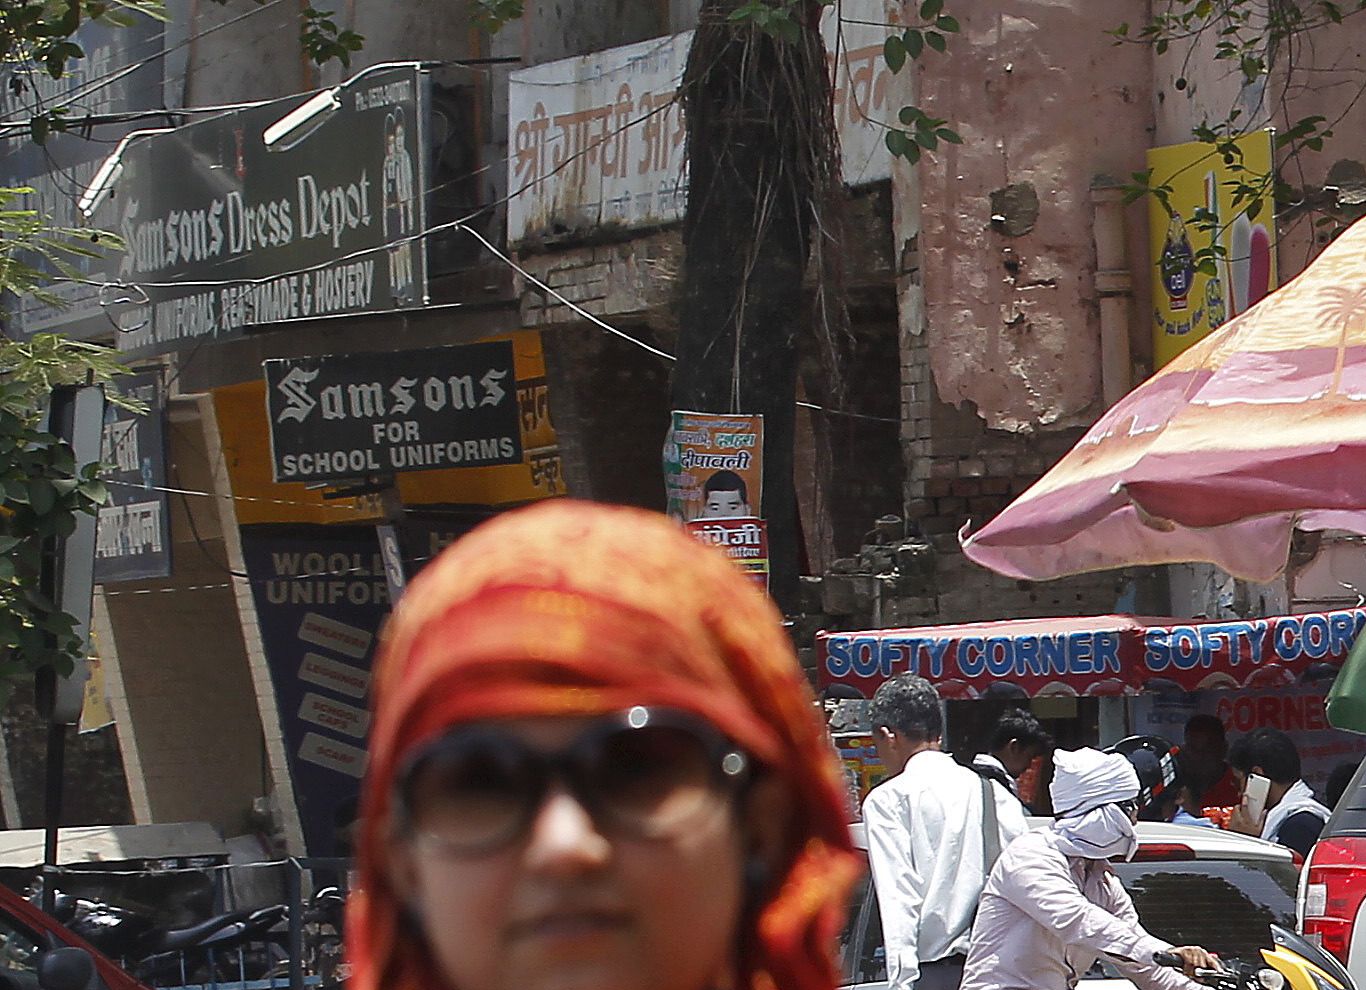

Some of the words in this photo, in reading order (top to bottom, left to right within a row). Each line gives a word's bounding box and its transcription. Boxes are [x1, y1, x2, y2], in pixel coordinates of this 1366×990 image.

[120, 197, 224, 278] Samsons
[226, 190, 293, 253] Dress
[298, 169, 371, 248] Depot
[315, 260, 374, 314] HOSIERY
[277, 366, 507, 424] Samsons
[373, 420, 420, 444] FOR
[282, 448, 380, 477] SCHOOL
[390, 437, 515, 468] UNIFORMS
[681, 450, 751, 470] दीपावली
[826, 635, 951, 677] SOFTY
[956, 630, 1121, 677] CORNER
[1144, 620, 1268, 671] SOFTY
[1217, 694, 1332, 733] CORNE
